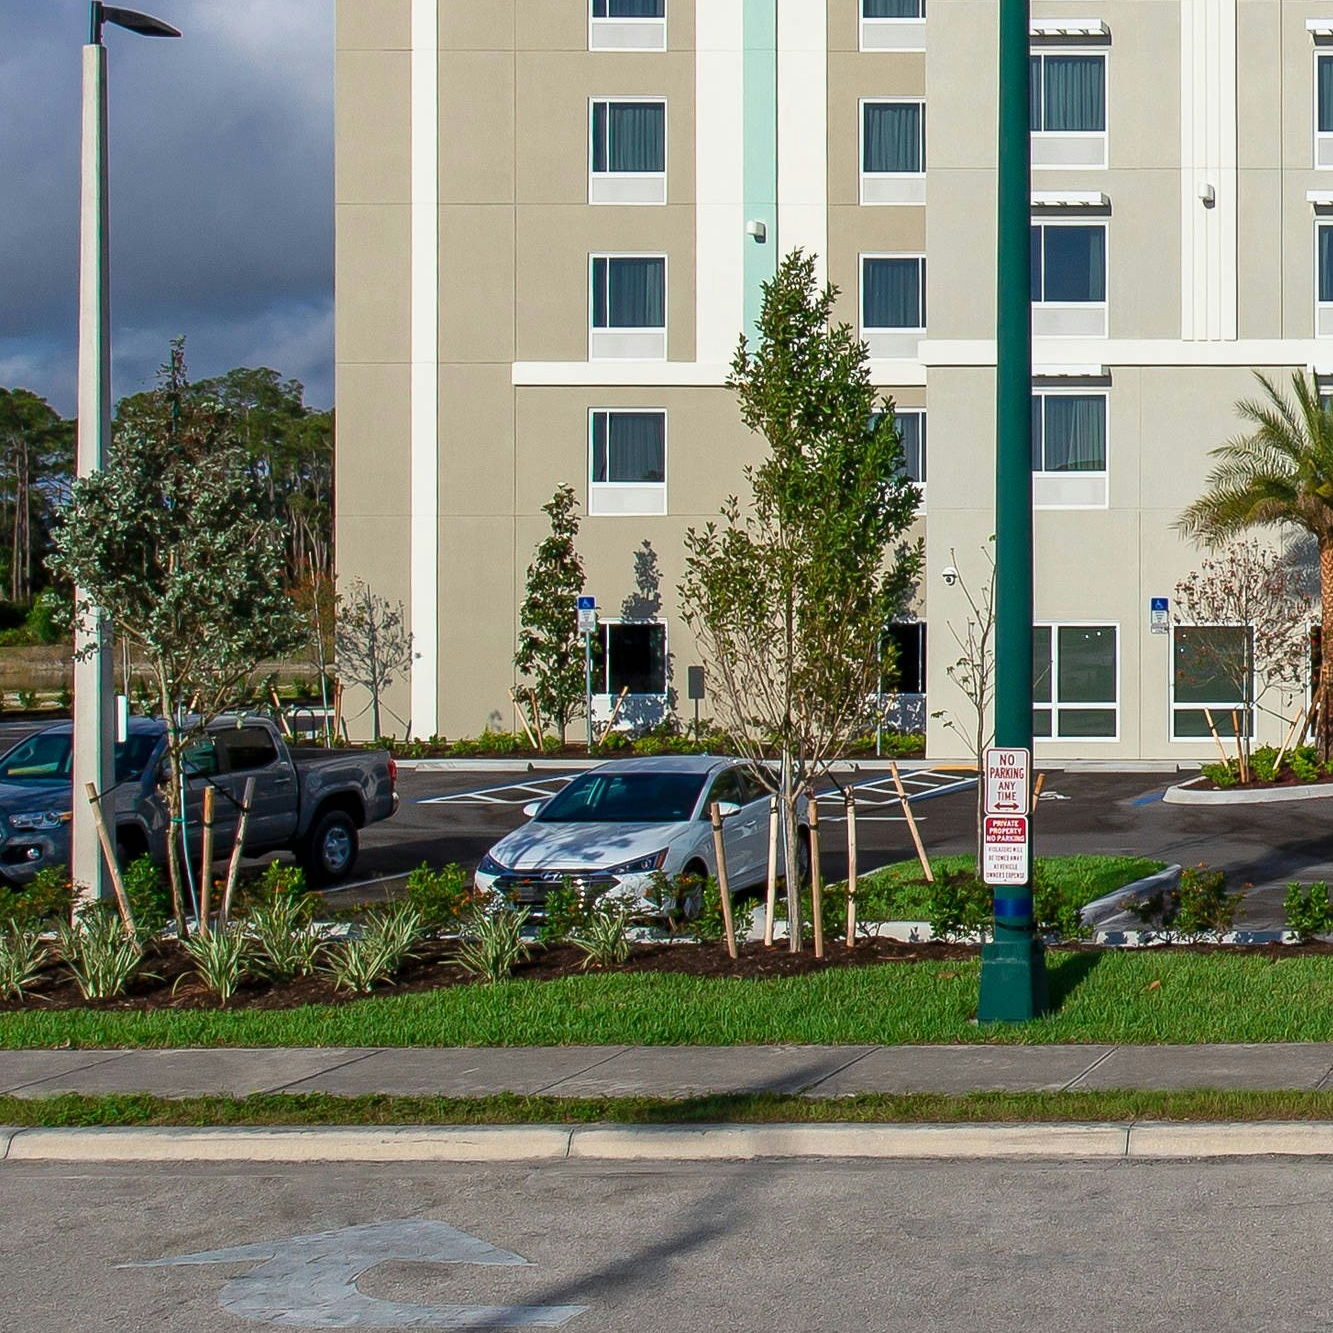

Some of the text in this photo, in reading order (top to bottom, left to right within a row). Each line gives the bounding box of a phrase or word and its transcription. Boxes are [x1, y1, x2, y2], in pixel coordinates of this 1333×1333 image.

[999, 754, 1015, 766] NO
[990, 767, 1025, 779] PARKING
[998, 781, 1016, 790] ANY
[997, 792, 1017, 801] TIME
[989, 827, 1022, 835] PROPERTY
